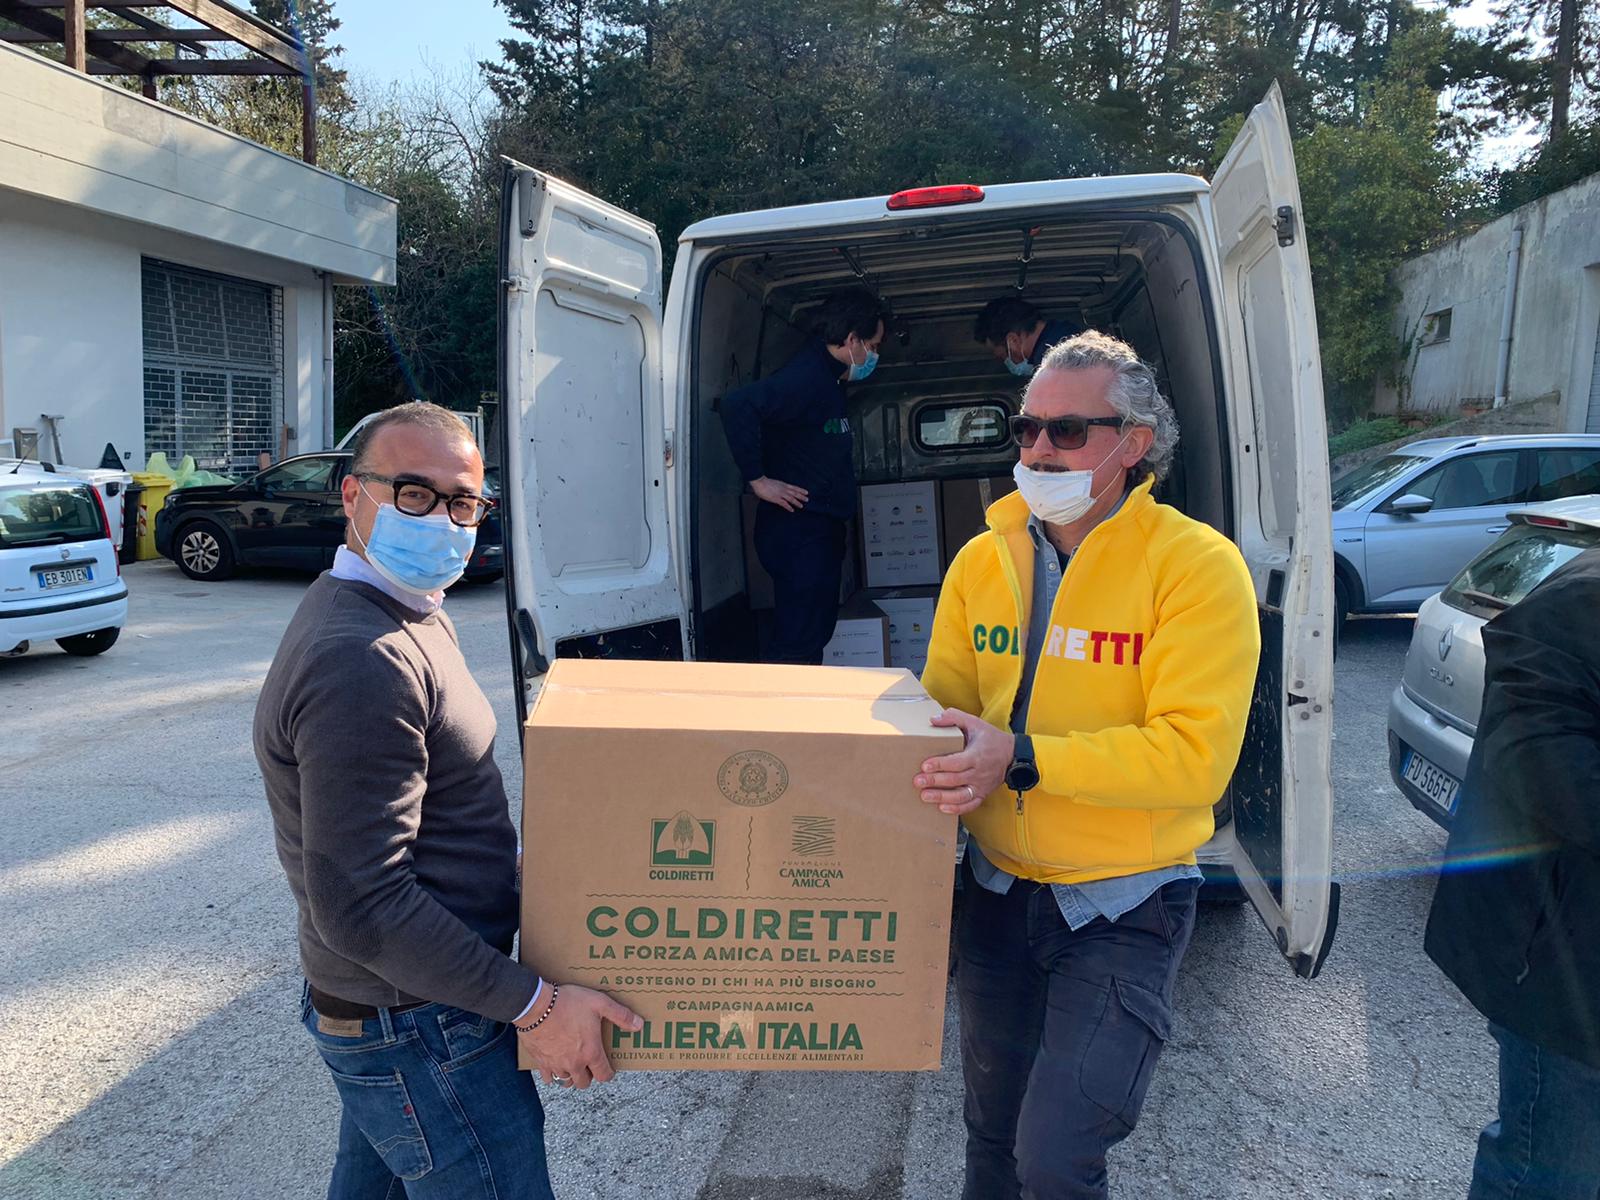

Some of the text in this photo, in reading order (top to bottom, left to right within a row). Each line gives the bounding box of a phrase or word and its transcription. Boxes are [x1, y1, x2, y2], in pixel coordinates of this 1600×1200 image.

[45, 569, 88, 586] EB 301EN
[649, 870, 714, 881] COLDIRETTI
[779, 868, 844, 879] CAMPAGNA
[792, 878, 830, 888] AMICA
[586, 906, 897, 942] COLDIRETTI
[589, 944, 895, 964] LA FORZA AMICA DEL PAESE
[600, 975, 876, 989] A SOSTEGNO DI CHI HA PIÙ BISOGNO
[666, 1000, 814, 1012] #CAMPAGNAAMICA
[757, 1022, 863, 1050] ITALIA
[611, 1052, 864, 1062] COLTIVARE E PRODURRE ECCELLENZE ALIMENTARI
